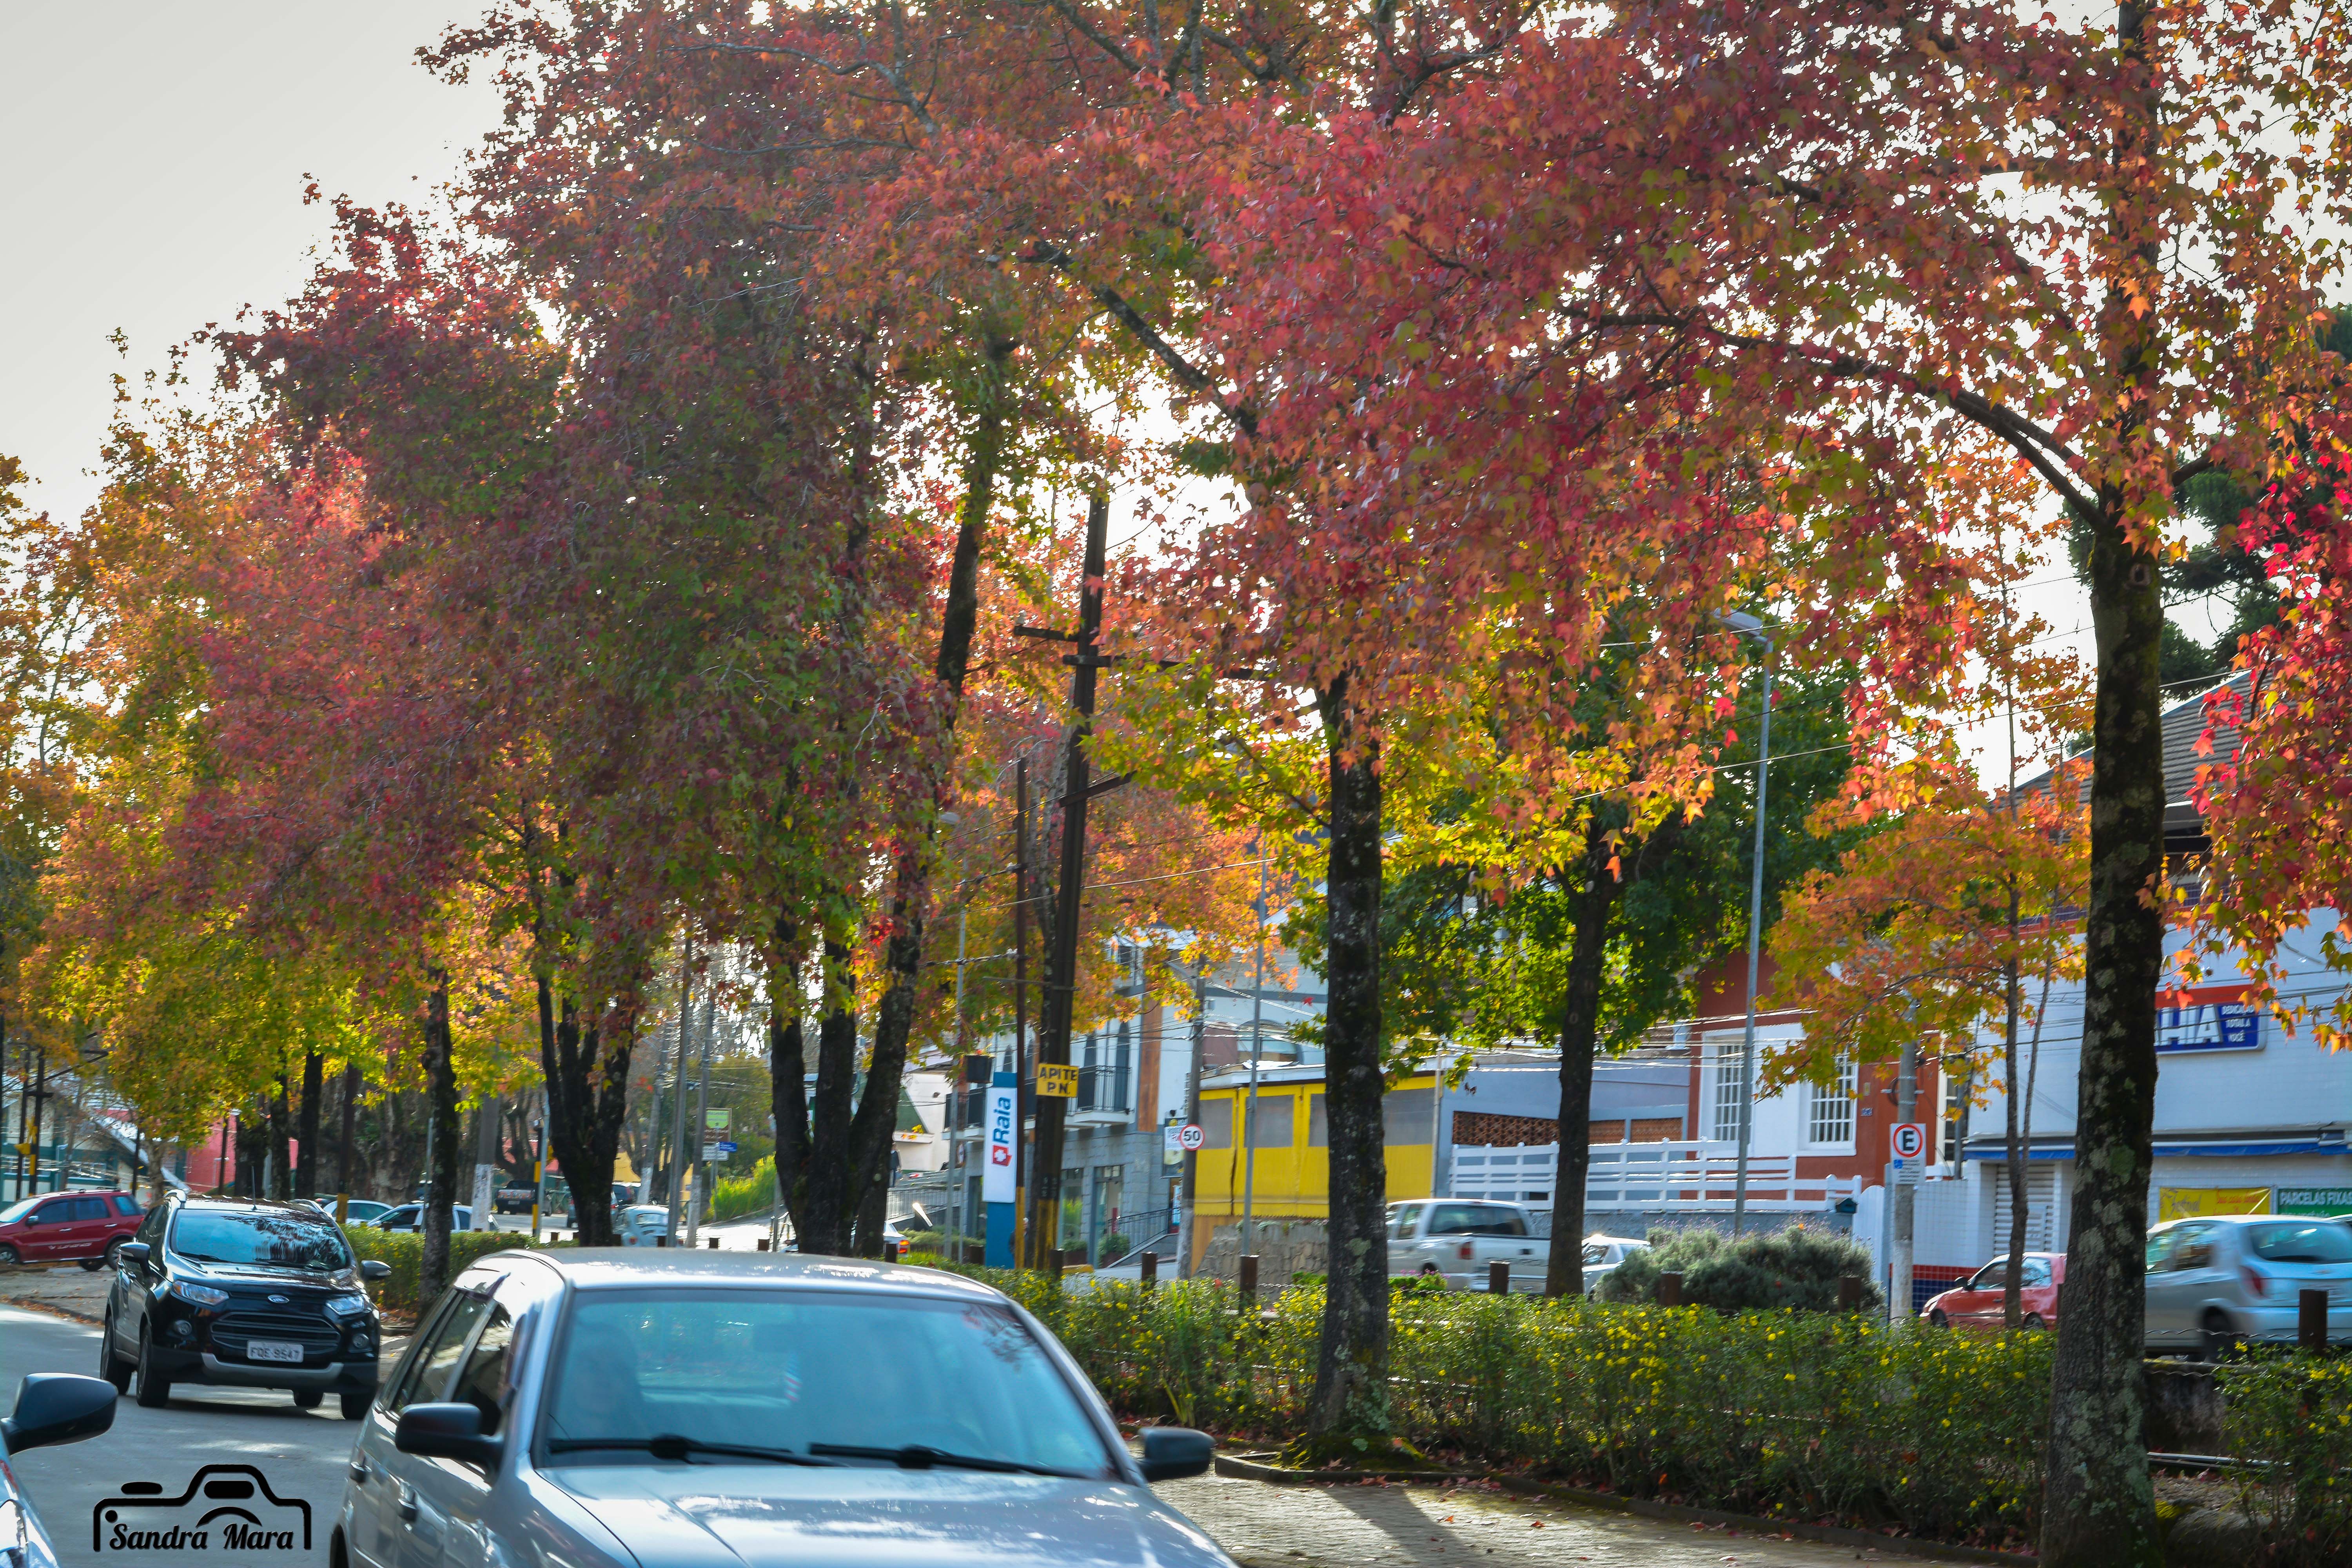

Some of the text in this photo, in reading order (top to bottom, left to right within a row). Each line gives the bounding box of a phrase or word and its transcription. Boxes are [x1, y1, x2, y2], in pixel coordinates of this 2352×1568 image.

[2226, 1018, 2251, 1028] TOTAL A
[2228, 1029, 2245, 1042] VOCÊ
[1040, 1067, 1076, 1080] APITE
[993, 1097, 1011, 1144] Raia
[1184, 1131, 1200, 1142] 50
[1903, 1131, 1914, 1151] E
[2280, 1191, 2326, 1205] PARCELAS
